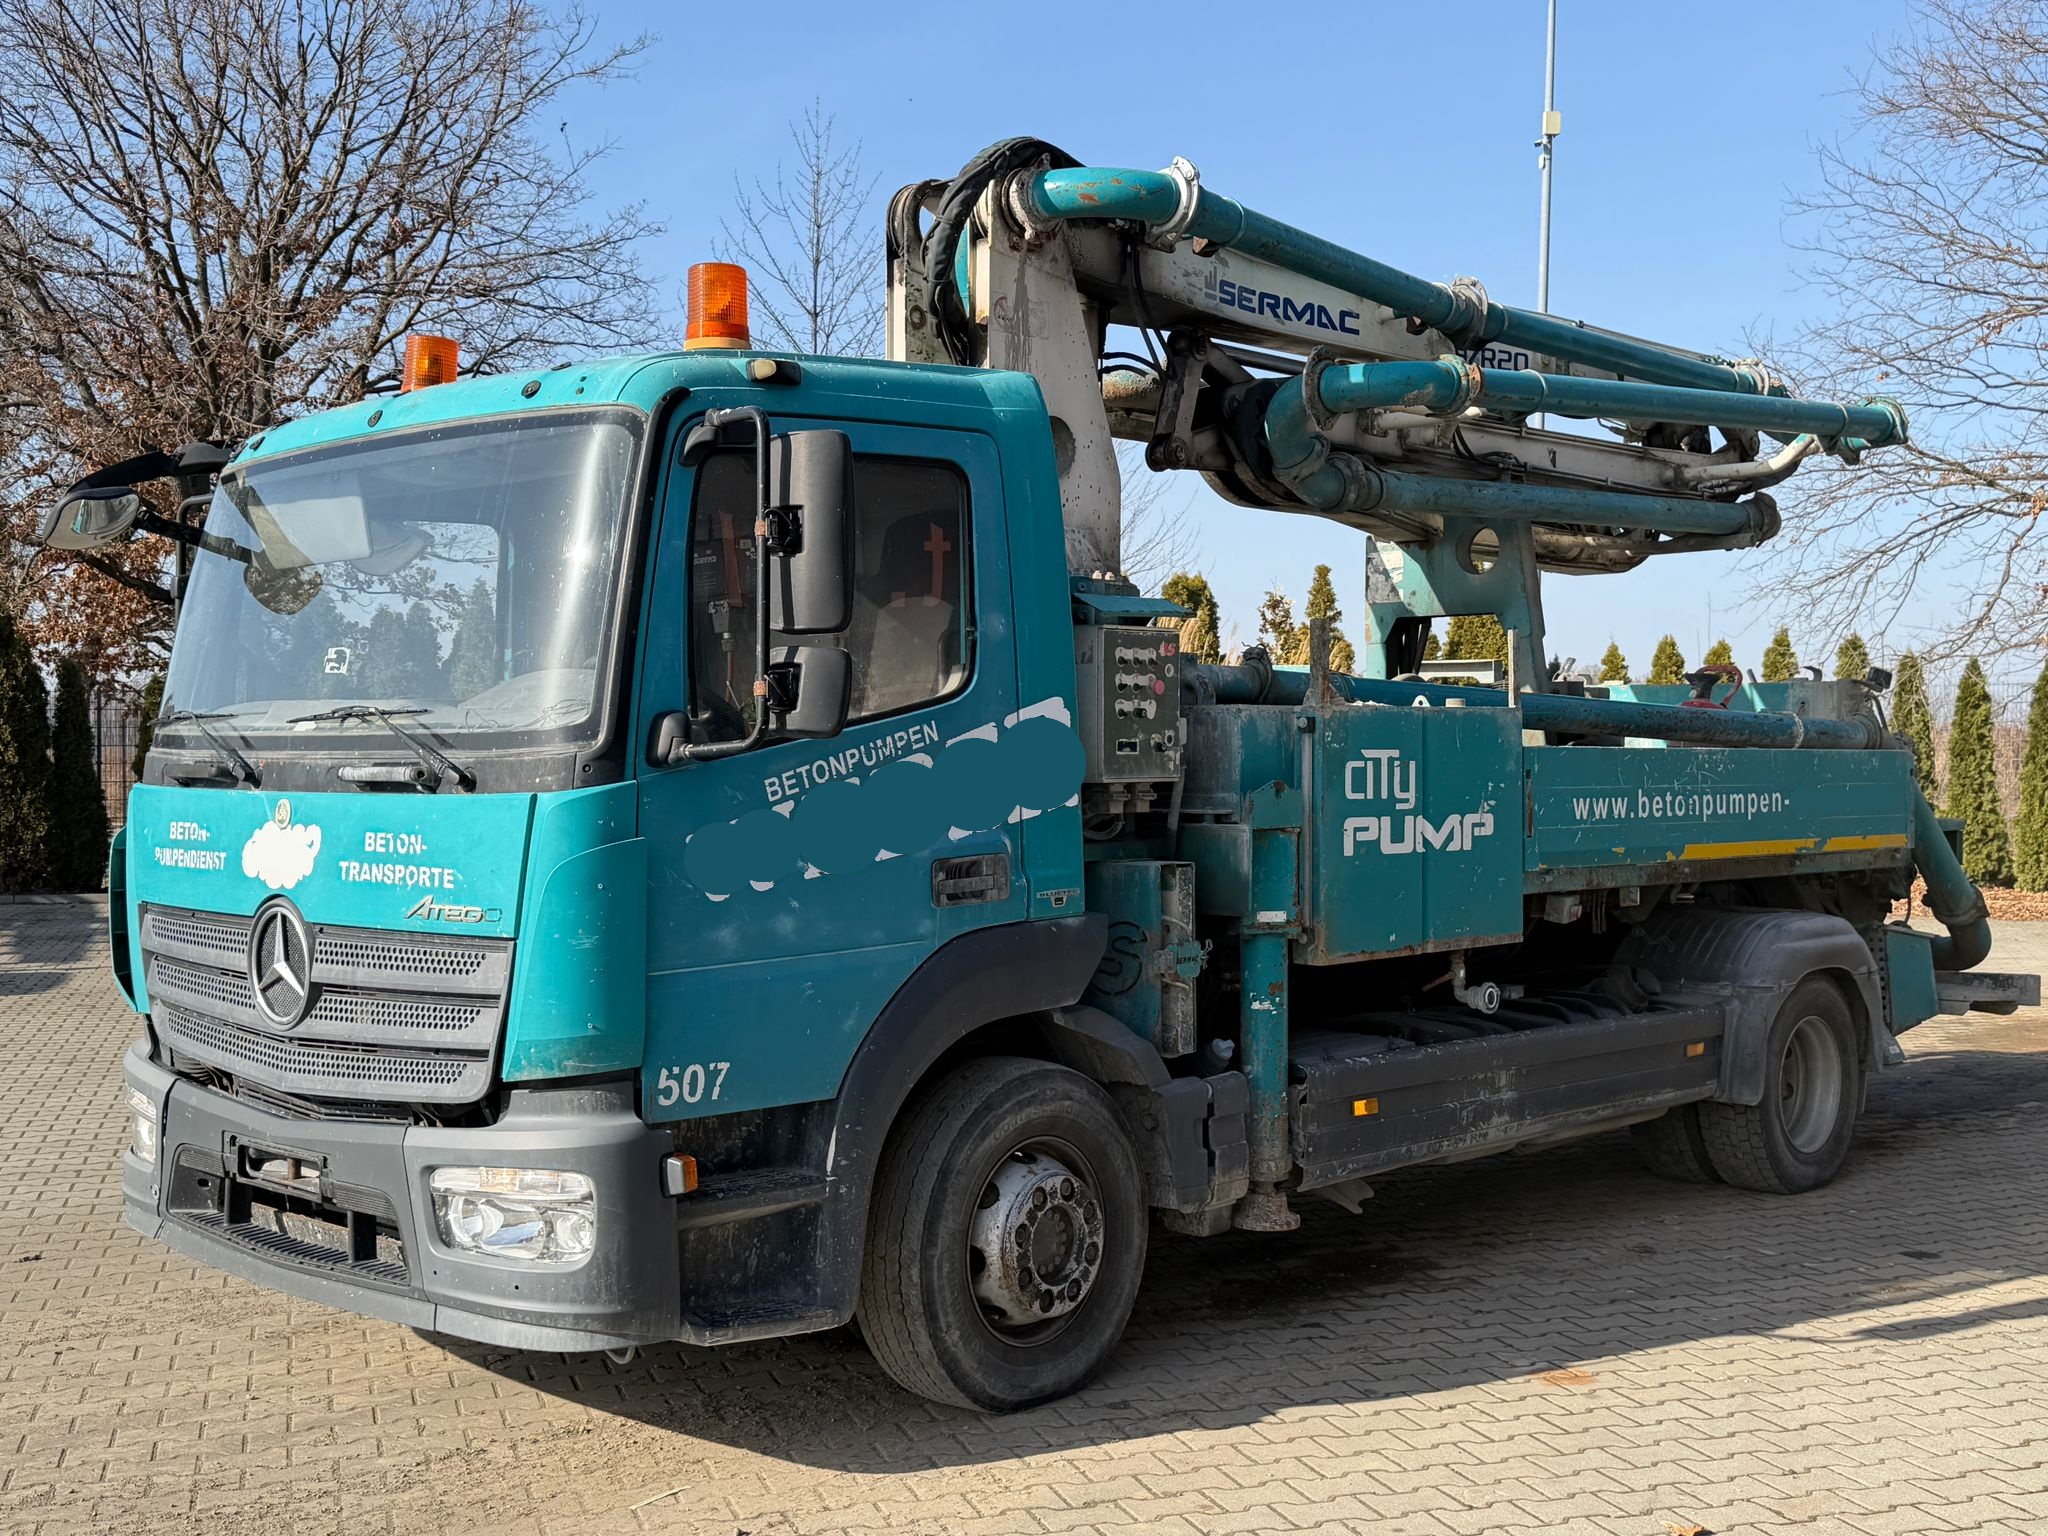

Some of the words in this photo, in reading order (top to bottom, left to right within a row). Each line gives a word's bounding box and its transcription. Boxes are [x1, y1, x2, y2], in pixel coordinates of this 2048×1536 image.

[1218, 279, 1360, 336] SERMAC
[763, 720, 939, 802] BETONPUMPEN
[1573, 790, 1790, 822] www.betonpumpen-
[364, 831, 428, 855] BETON-
[1343, 813, 1494, 857] PUMP
[338, 860, 456, 889] TRANSPORTE
[657, 1061, 731, 1107] 507
